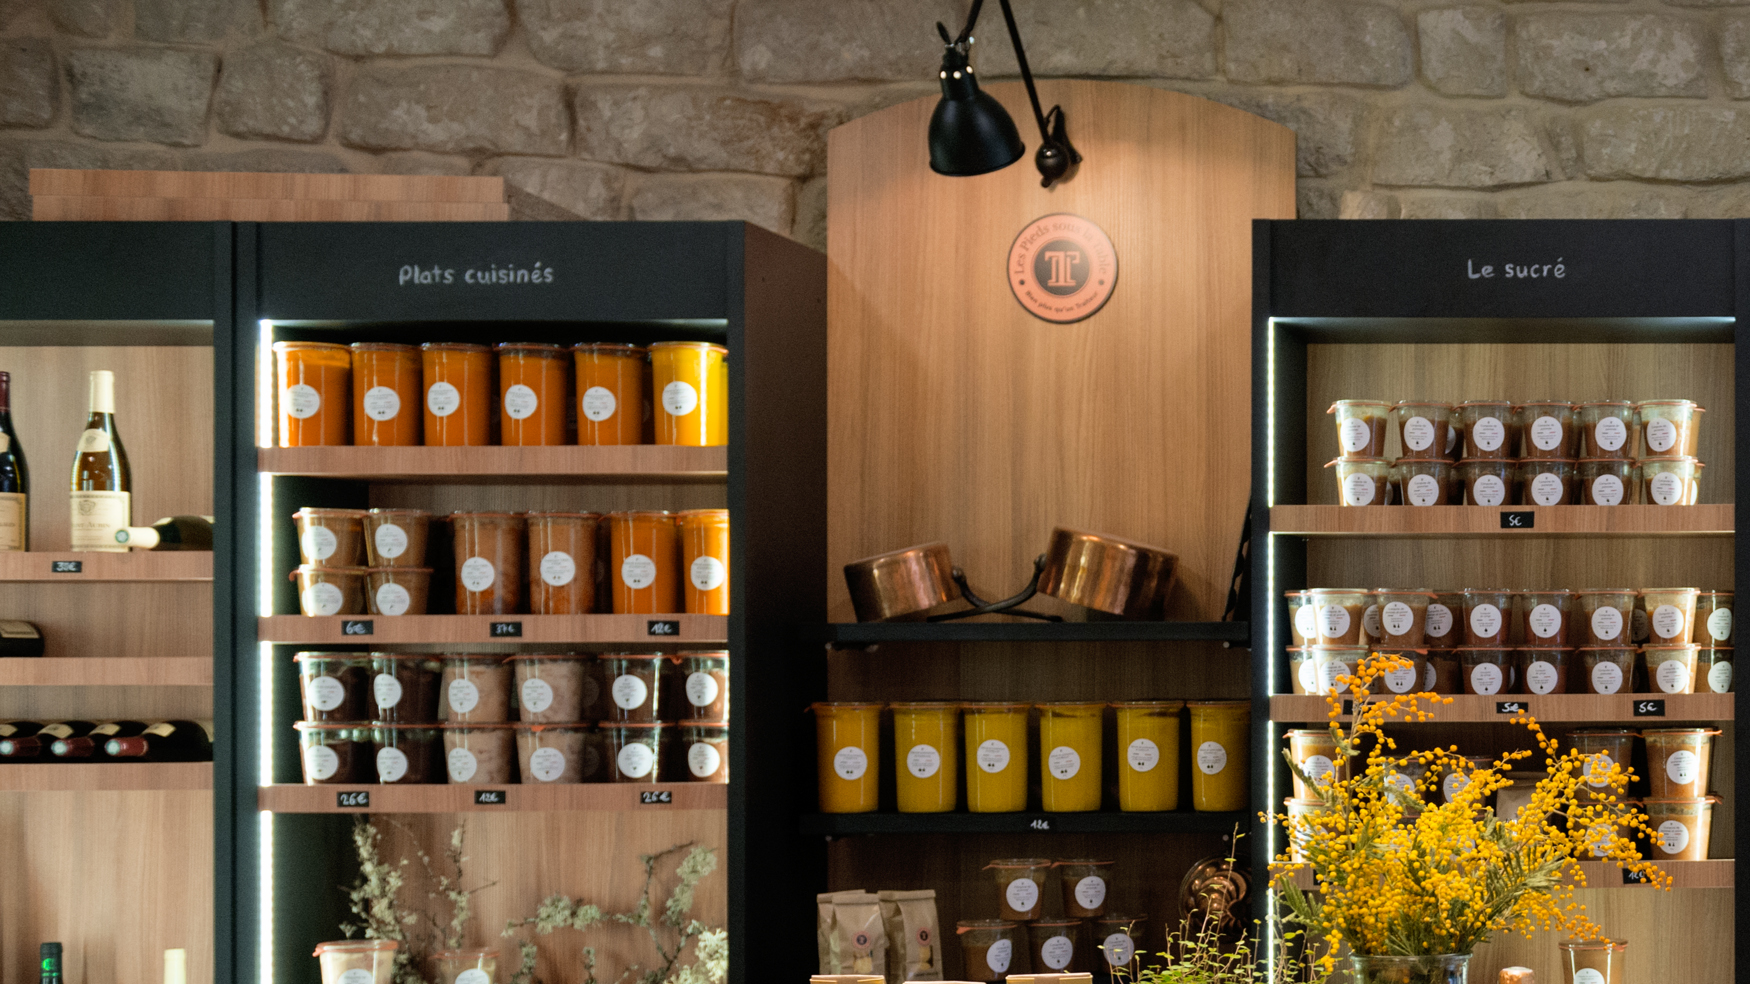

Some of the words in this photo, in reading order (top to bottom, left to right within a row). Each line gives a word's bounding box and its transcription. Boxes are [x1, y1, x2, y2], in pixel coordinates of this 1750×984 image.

[1019, 224, 1050, 252] Pieds
[398, 264, 455, 285] Plats
[464, 260, 554, 284] cuisinés
[1467, 259, 1495, 279] Le
[1504, 257, 1566, 279] sucré
[346, 621, 367, 634] 6€
[1638, 701, 1658, 713] 5€
[340, 792, 368, 805] 26€
[643, 791, 670, 803] 26€
